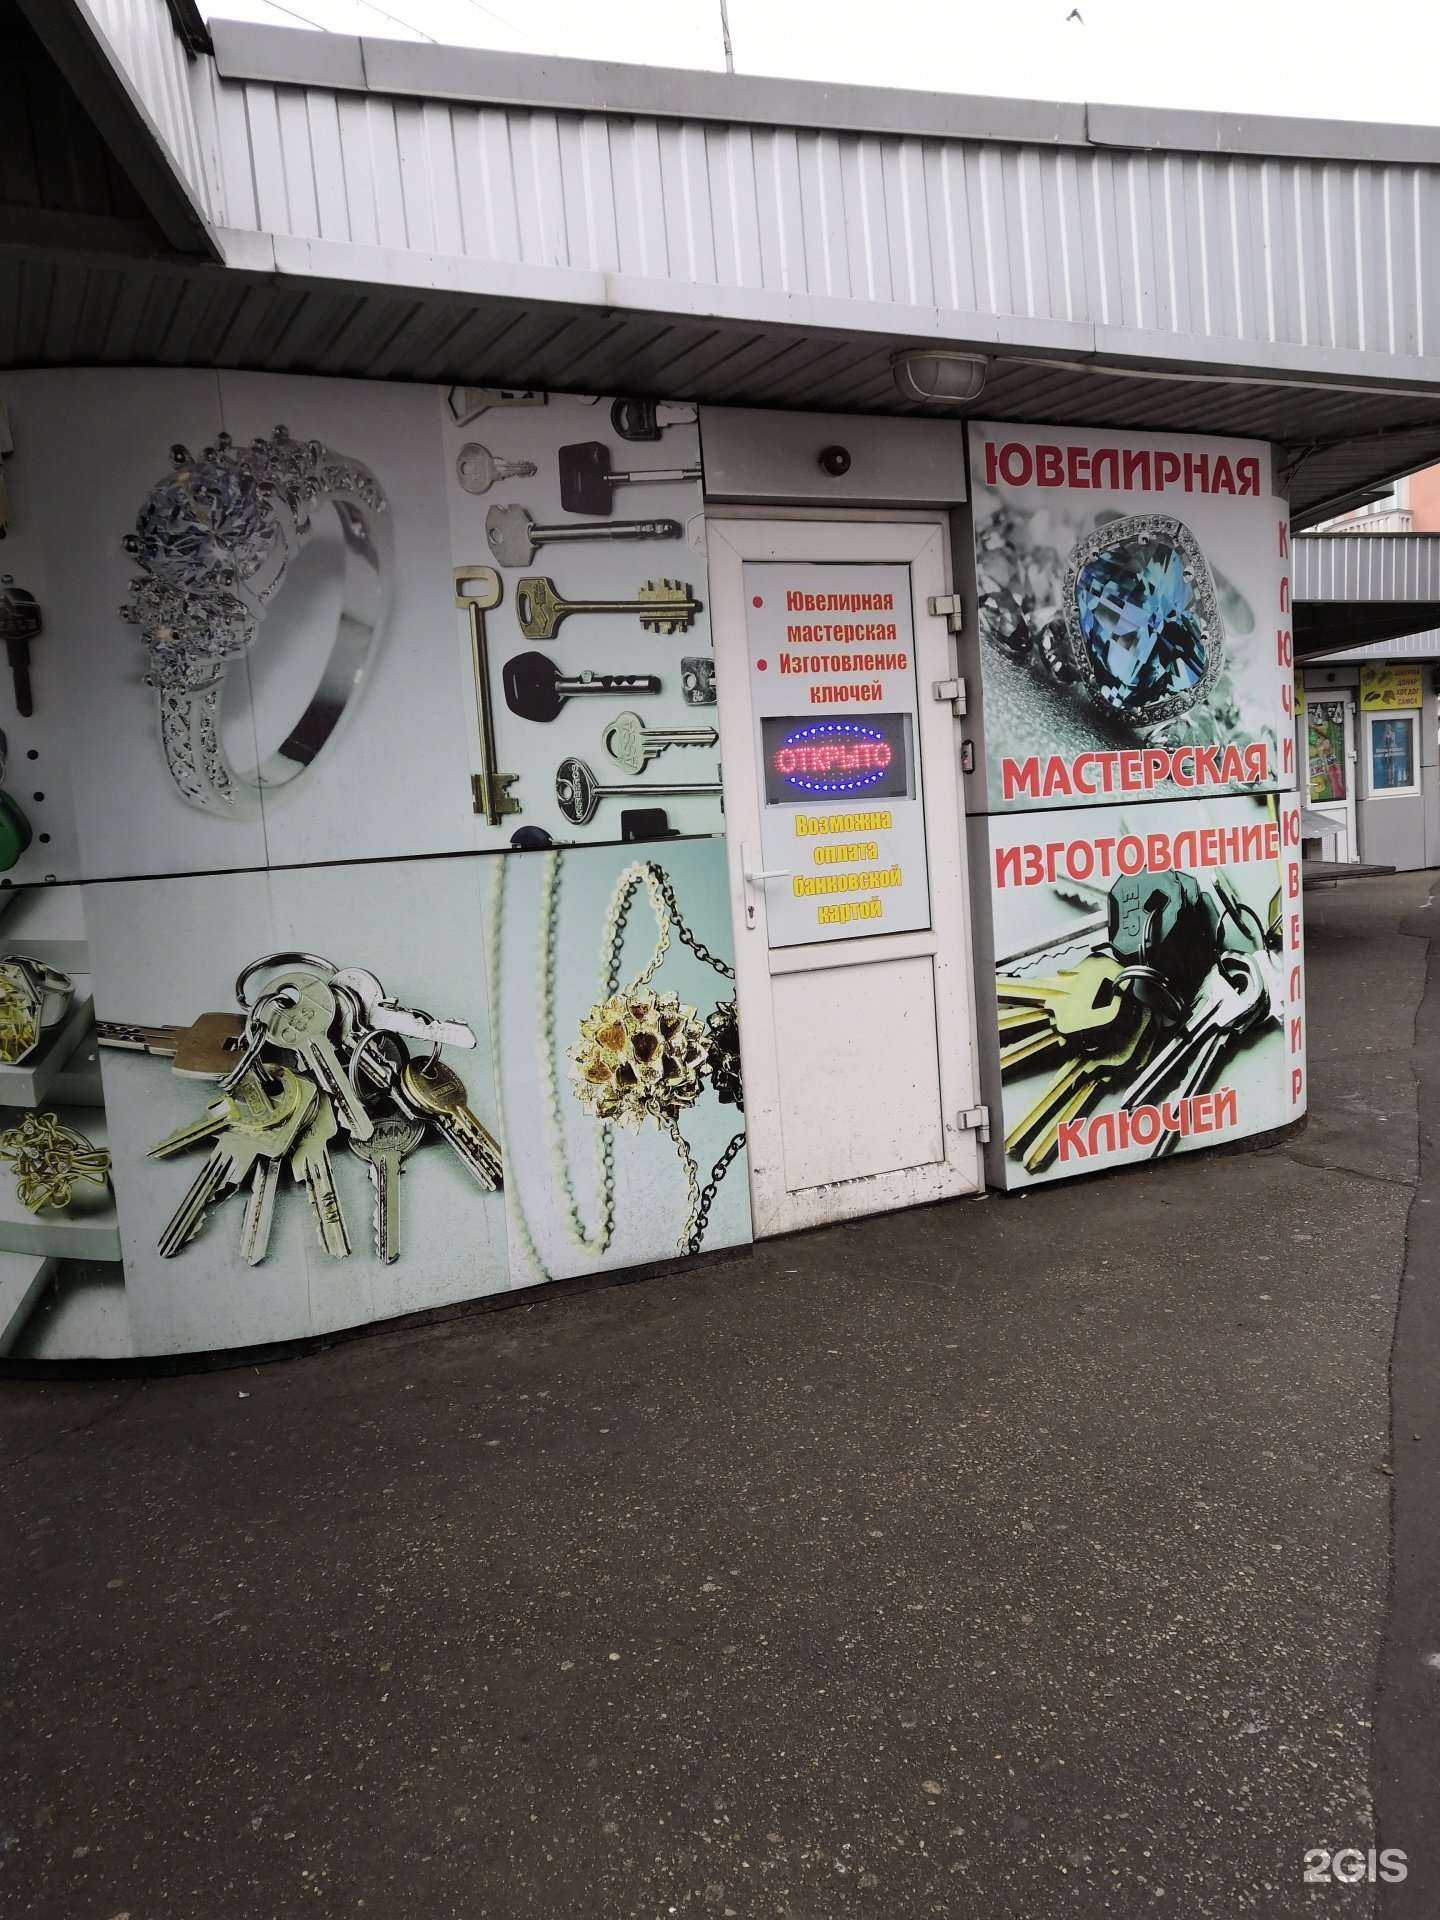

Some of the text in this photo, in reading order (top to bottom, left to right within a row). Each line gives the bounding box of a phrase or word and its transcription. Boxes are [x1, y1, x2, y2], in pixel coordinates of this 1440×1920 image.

[985, 442, 1260, 497] ЮВЕЛИРНАЯ
[786, 590, 894, 613] Ювелирная
[786, 622, 897, 645] мастерская
[779, 652, 908, 676] Изготовление
[808, 679, 883, 705] ключей
[775, 742, 891, 774] ОТКРЫТО
[1002, 743, 1268, 800] МАСТЕРСКАЯ
[795, 810, 892, 837] Возможна
[813, 840, 878, 865] оплата
[995, 822, 1279, 889] ИЗГОТОВЛЕНИЕ
[792, 864, 902, 897] банковской
[817, 896, 883, 925] картой
[1057, 1087, 1237, 1162] КЛЮЧЕЙ
